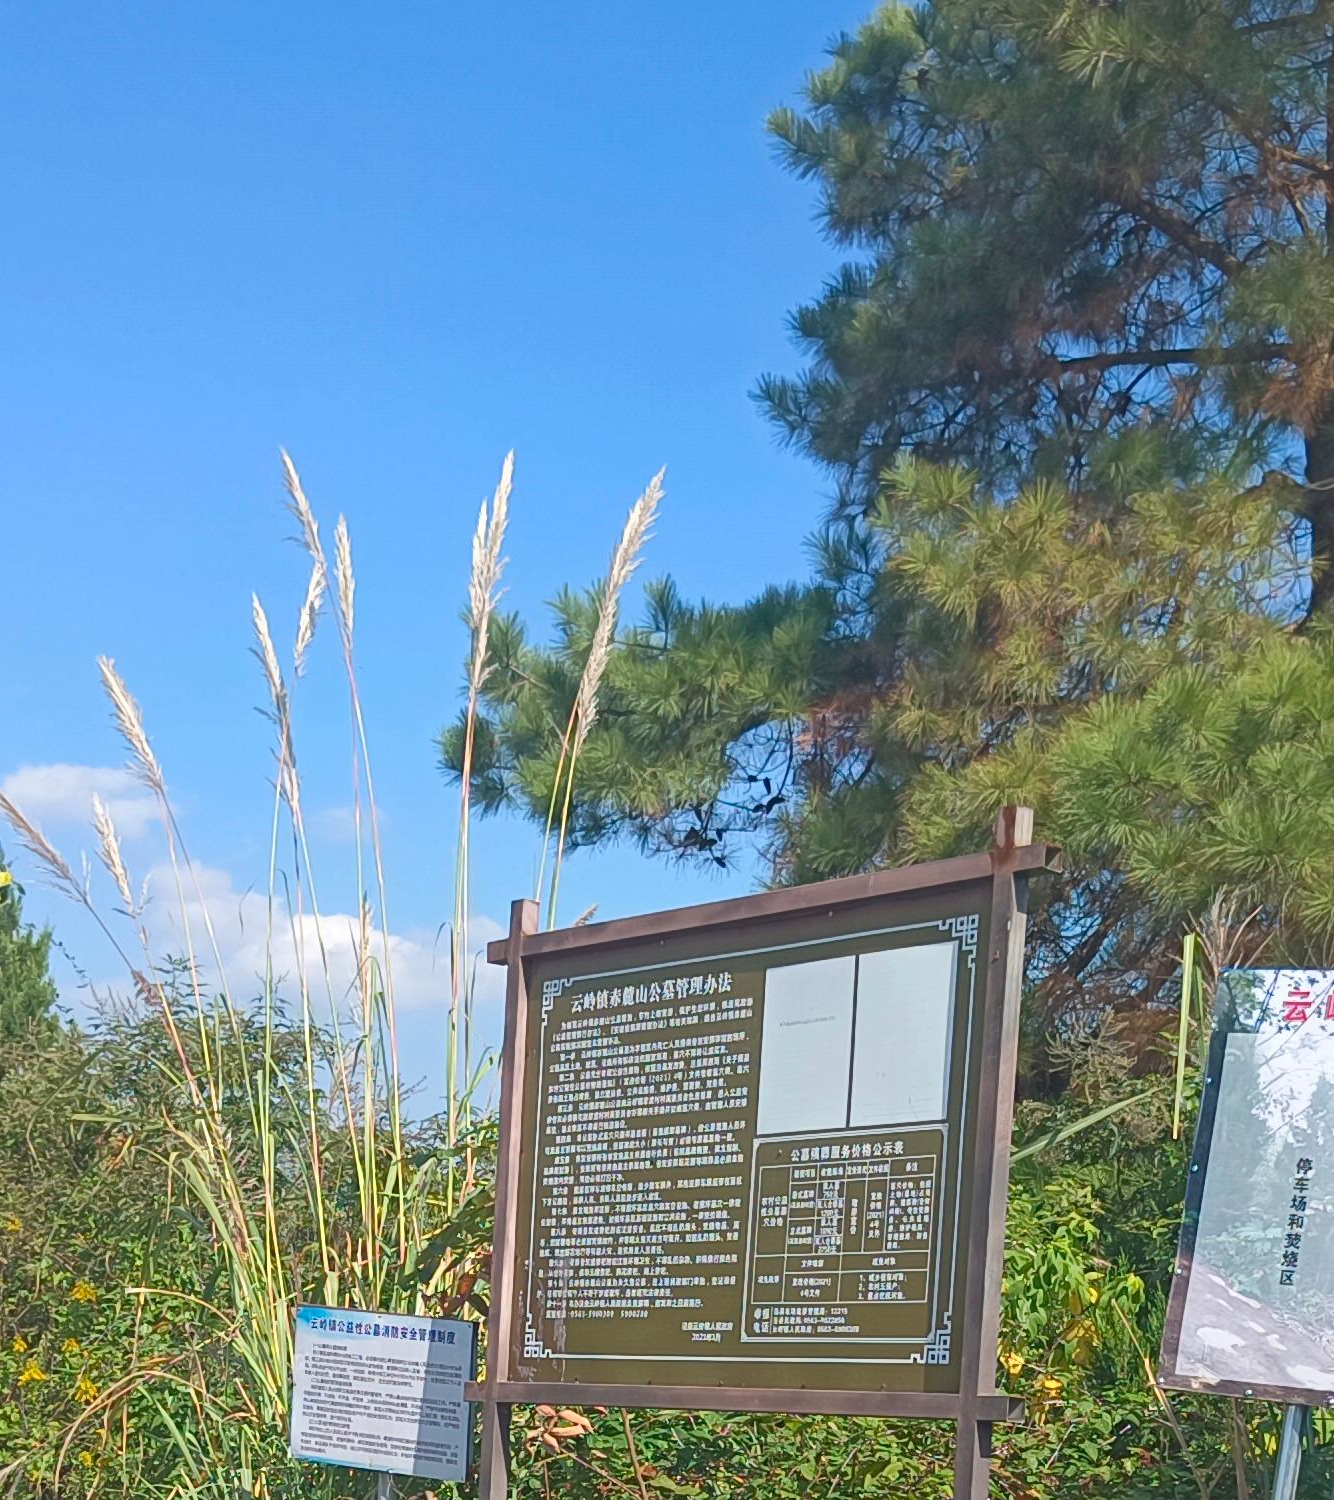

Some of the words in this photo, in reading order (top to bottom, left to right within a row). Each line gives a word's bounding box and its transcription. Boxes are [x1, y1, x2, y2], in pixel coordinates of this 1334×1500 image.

[1279, 1157, 1314, 1286] 停车场和焚烧区
